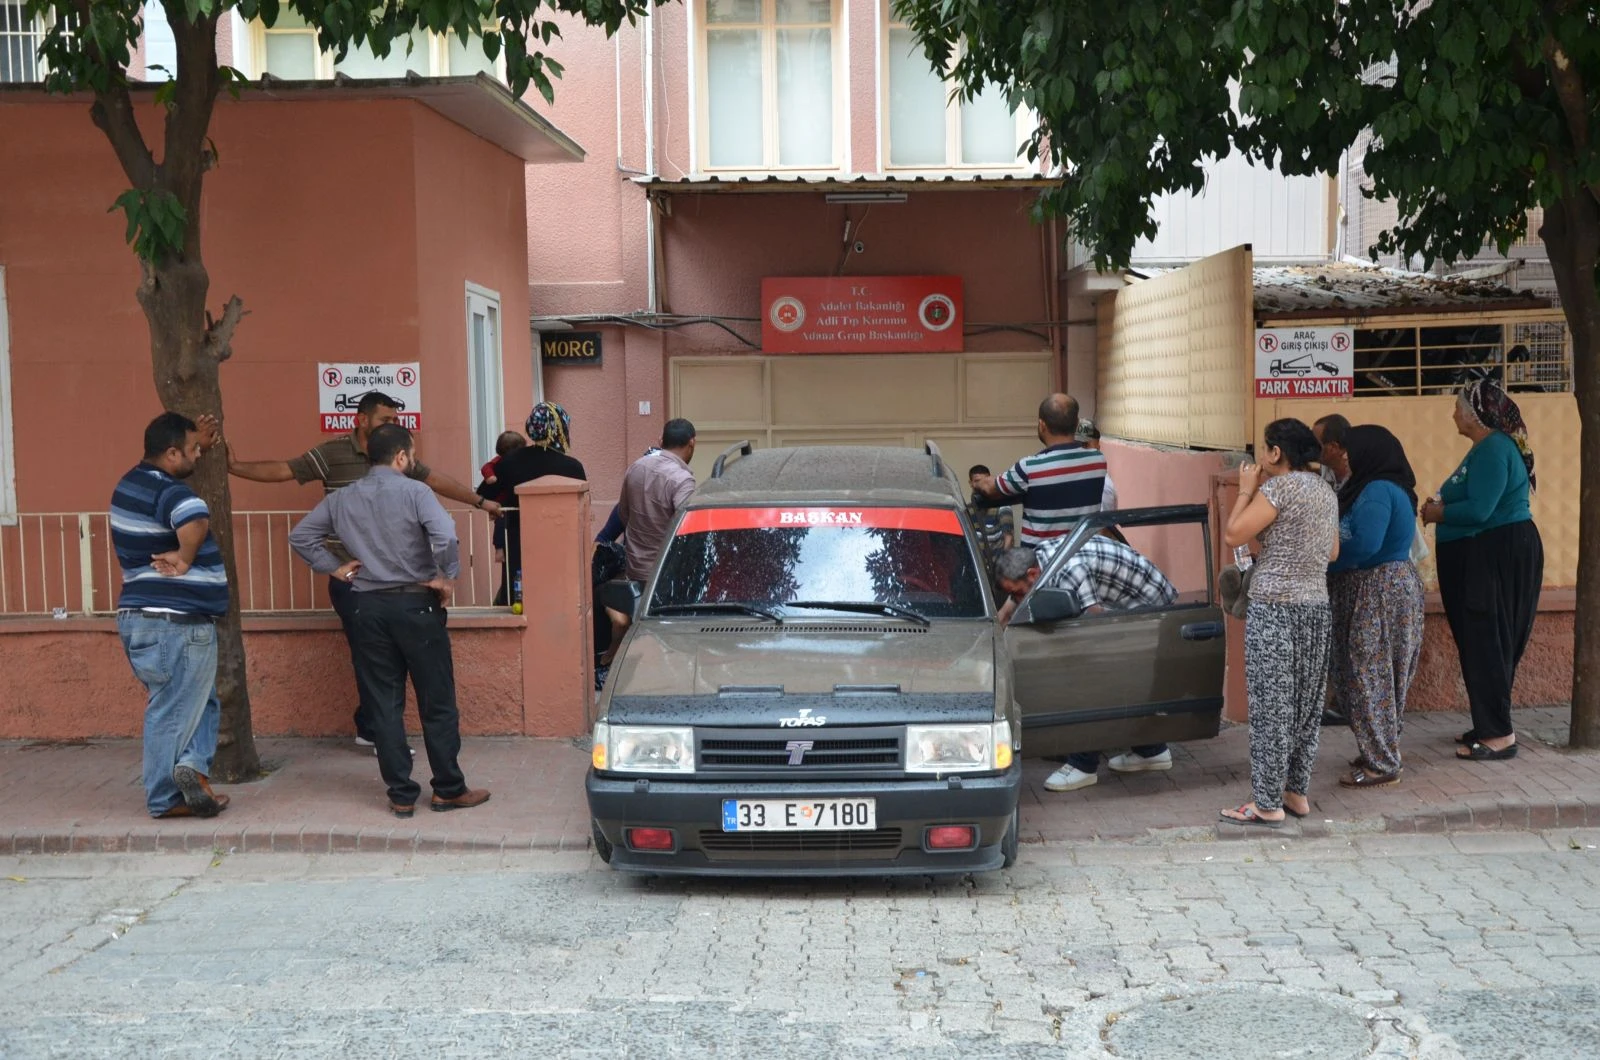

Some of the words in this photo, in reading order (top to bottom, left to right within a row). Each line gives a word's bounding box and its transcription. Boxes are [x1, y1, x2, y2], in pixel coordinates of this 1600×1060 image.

[837, 331, 866, 342] Grup
[1294, 331, 1316, 341] ARAÇ
[544, 340, 595, 357] MORG
[358, 365, 380, 375] ARAÇ
[1260, 381, 1290, 394] PARK
[1293, 380, 1349, 394] YASAKTIR
[325, 415, 355, 429] PARK
[739, 804, 765, 827] 33
[785, 804, 797, 826] E
[813, 802, 868, 826] 7180
